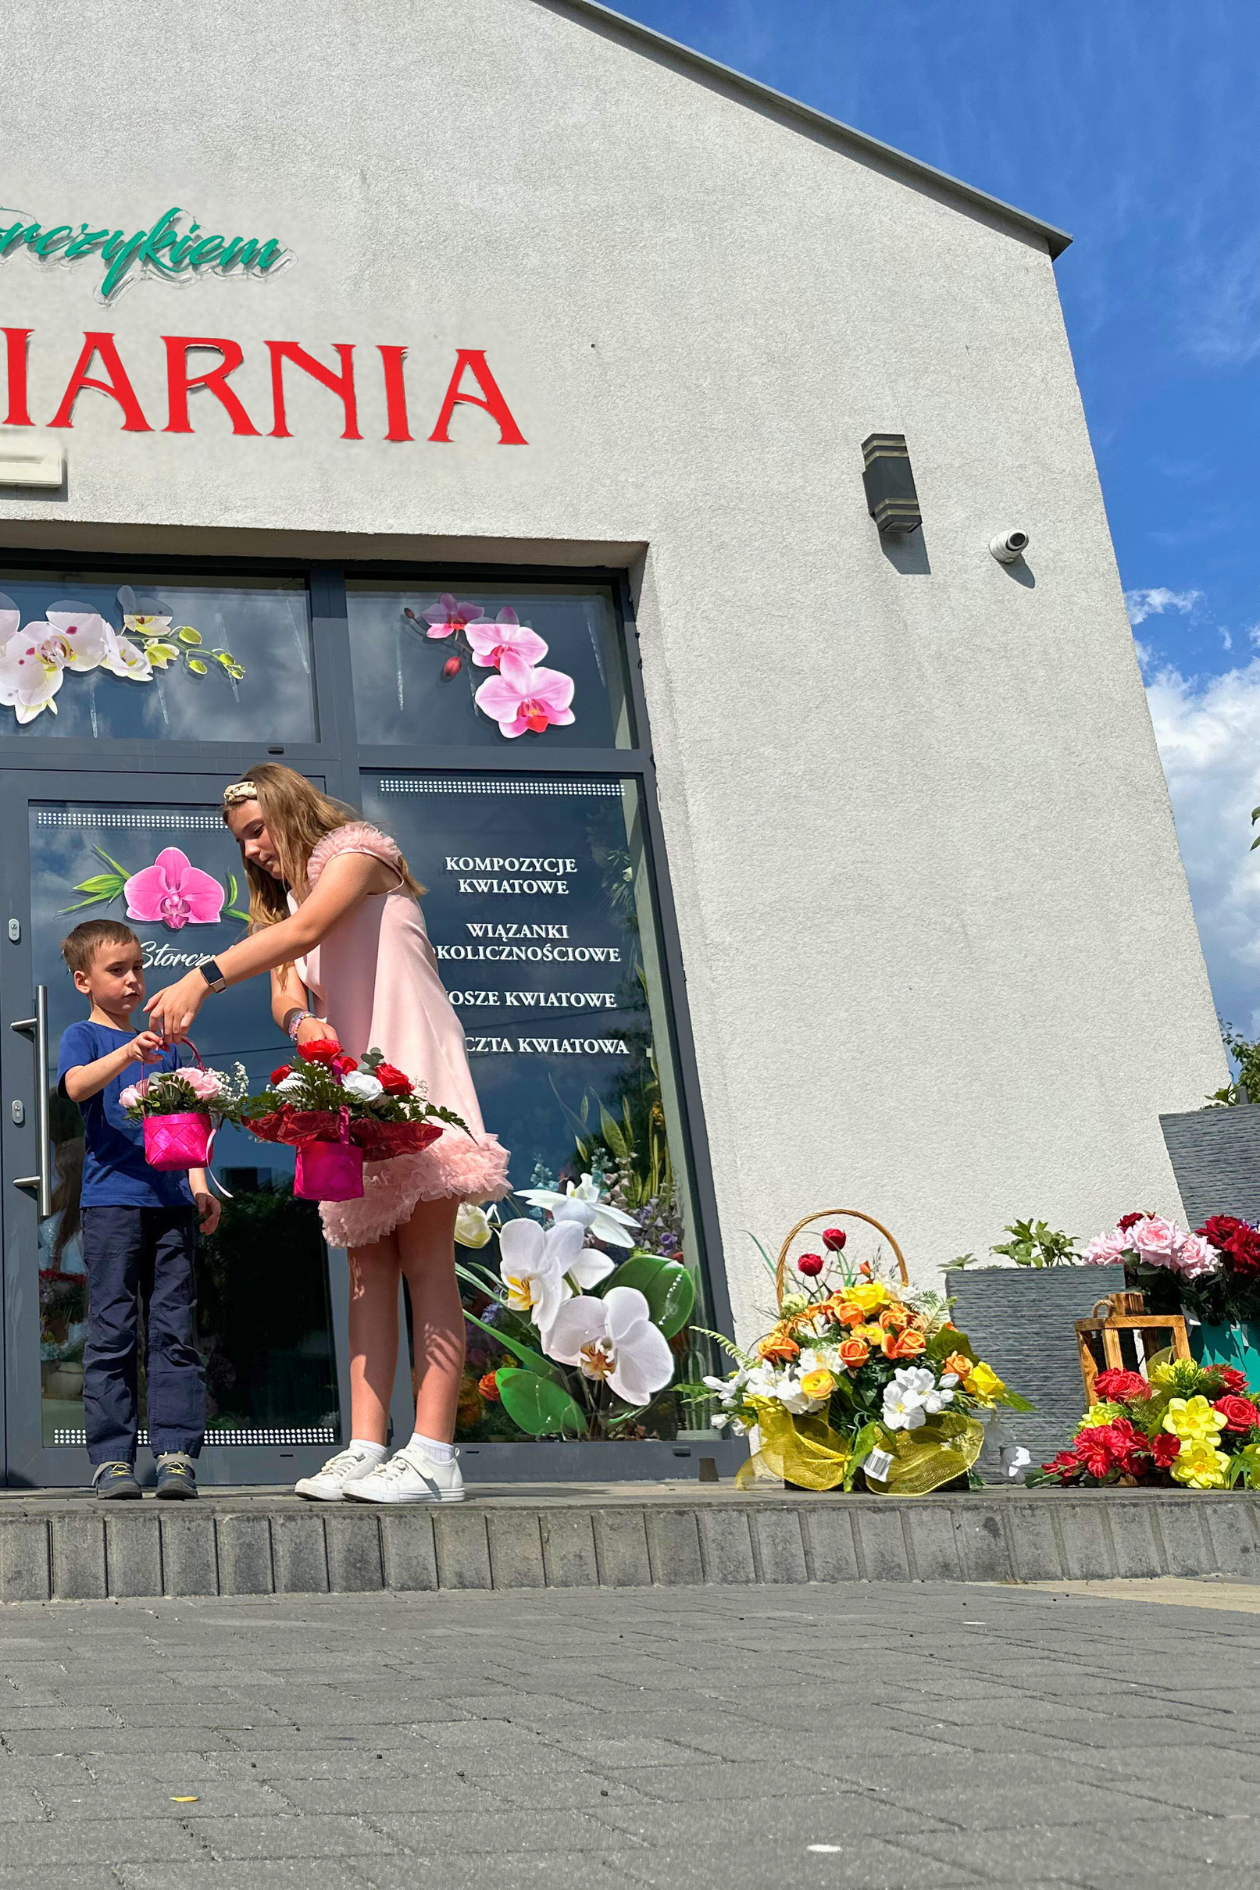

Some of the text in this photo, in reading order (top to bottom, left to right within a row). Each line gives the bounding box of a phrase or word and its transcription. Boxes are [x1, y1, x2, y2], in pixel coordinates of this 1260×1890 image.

[445, 857, 578, 876] KOMPOZYCJE
[458, 879, 569, 895] KWIATOWE
[466, 923, 569, 942] WIĄZANKI
[433, 943, 621, 962] KOLICZNOŚCIOWE
[446, 990, 617, 1008] OSZE KWIATOWE
[517, 1038, 631, 1055] KWIATOWA
